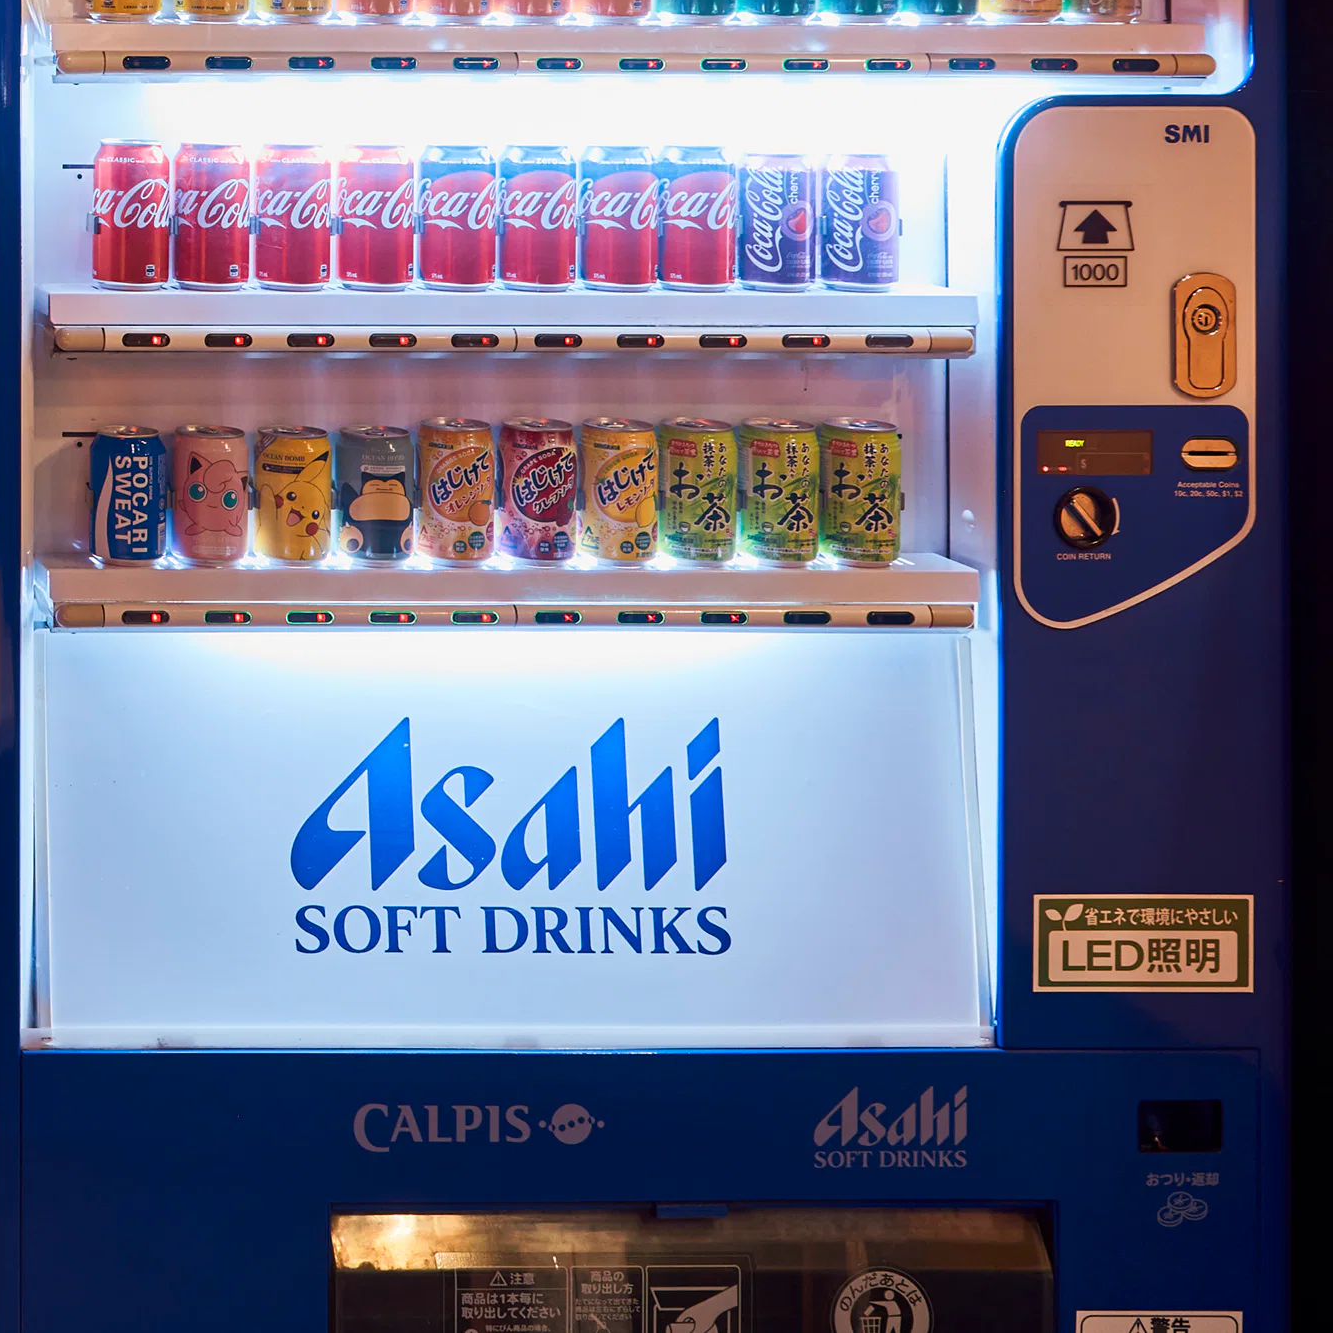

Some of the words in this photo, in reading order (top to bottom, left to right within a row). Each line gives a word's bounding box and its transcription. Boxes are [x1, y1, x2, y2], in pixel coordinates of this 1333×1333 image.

[1164, 124, 1210, 144] SMI
[791, 167, 801, 204] cherry
[1071, 263, 1120, 282] 1000
[431, 450, 490, 506] はじけて
[515, 451, 574, 507] はじけて
[1177, 481, 1217, 489] Acceptable
[114, 455, 132, 545] SWEAT
[132, 455, 149, 554] POCARI
[290, 716, 728, 892] Asahi
[294, 904, 462, 955] SOFT
[479, 904, 732, 956] DRINKS
[1084, 907, 1238, 927] 省エネで環境にやさしい
[1061, 938, 1221, 974] LED照明
[353, 1103, 532, 1153] CALPIS
[813, 1085, 969, 1147] Asahi
[814, 1151, 873, 1168] SOFT
[878, 1151, 968, 1169] DRINKS
[510, 1272, 535, 1286] 注意
[840, 1272, 922, 1312] のんだあとは
